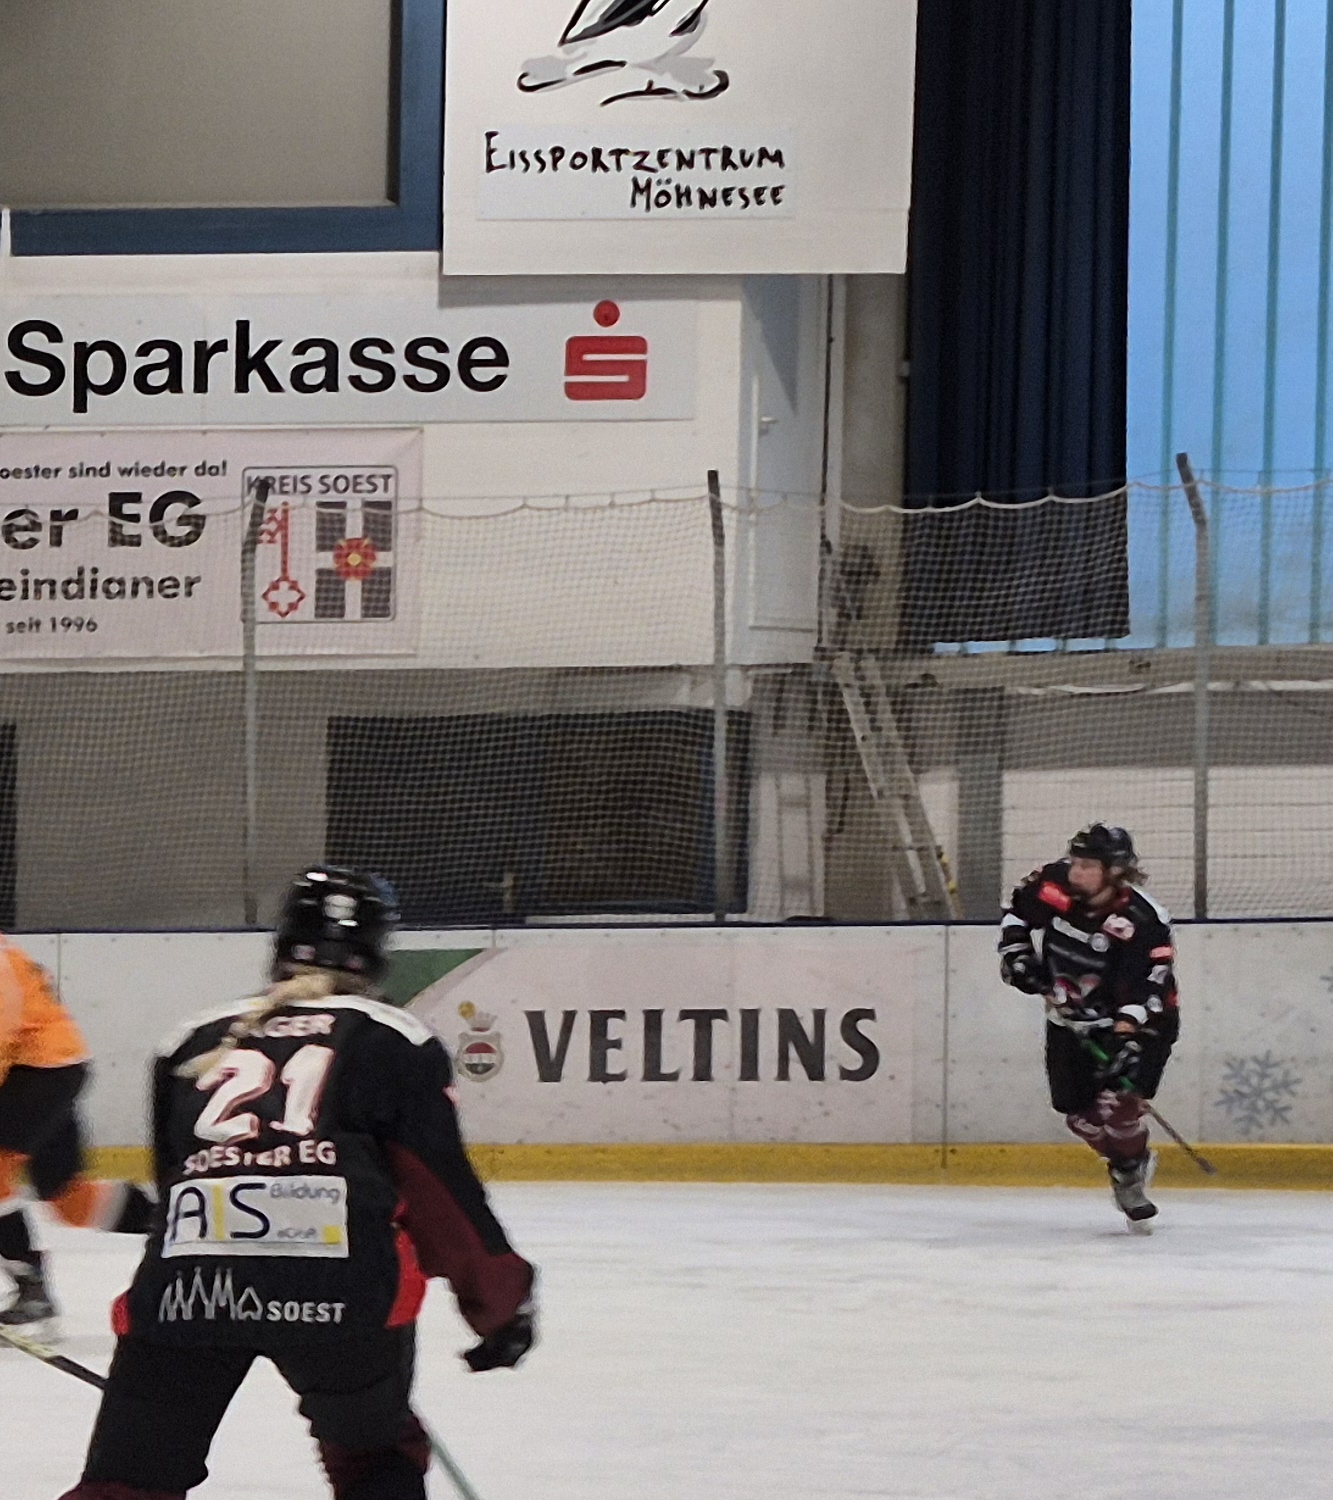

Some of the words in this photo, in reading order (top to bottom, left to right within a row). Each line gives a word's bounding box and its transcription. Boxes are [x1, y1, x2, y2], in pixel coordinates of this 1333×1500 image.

[484, 131, 786, 174] EISSPORTZENTRUM
[630, 177, 786, 213] MÖHNESEE
[4, 318, 511, 413] Sparkasse
[68, 460, 112, 479] sind
[117, 459, 189, 478] wieder
[194, 459, 228, 478] da!
[247, 474, 313, 495] KREIS
[318, 474, 394, 495] SOEST
[107, 489, 207, 549] EG
[6, 616, 42, 635] seit
[49, 616, 99, 634] 1996
[524, 1008, 881, 1084] VELTINS
[193, 1043, 334, 1144] 21
[299, 1139, 337, 1166] EG
[266, 1301, 346, 1324] SOEST
